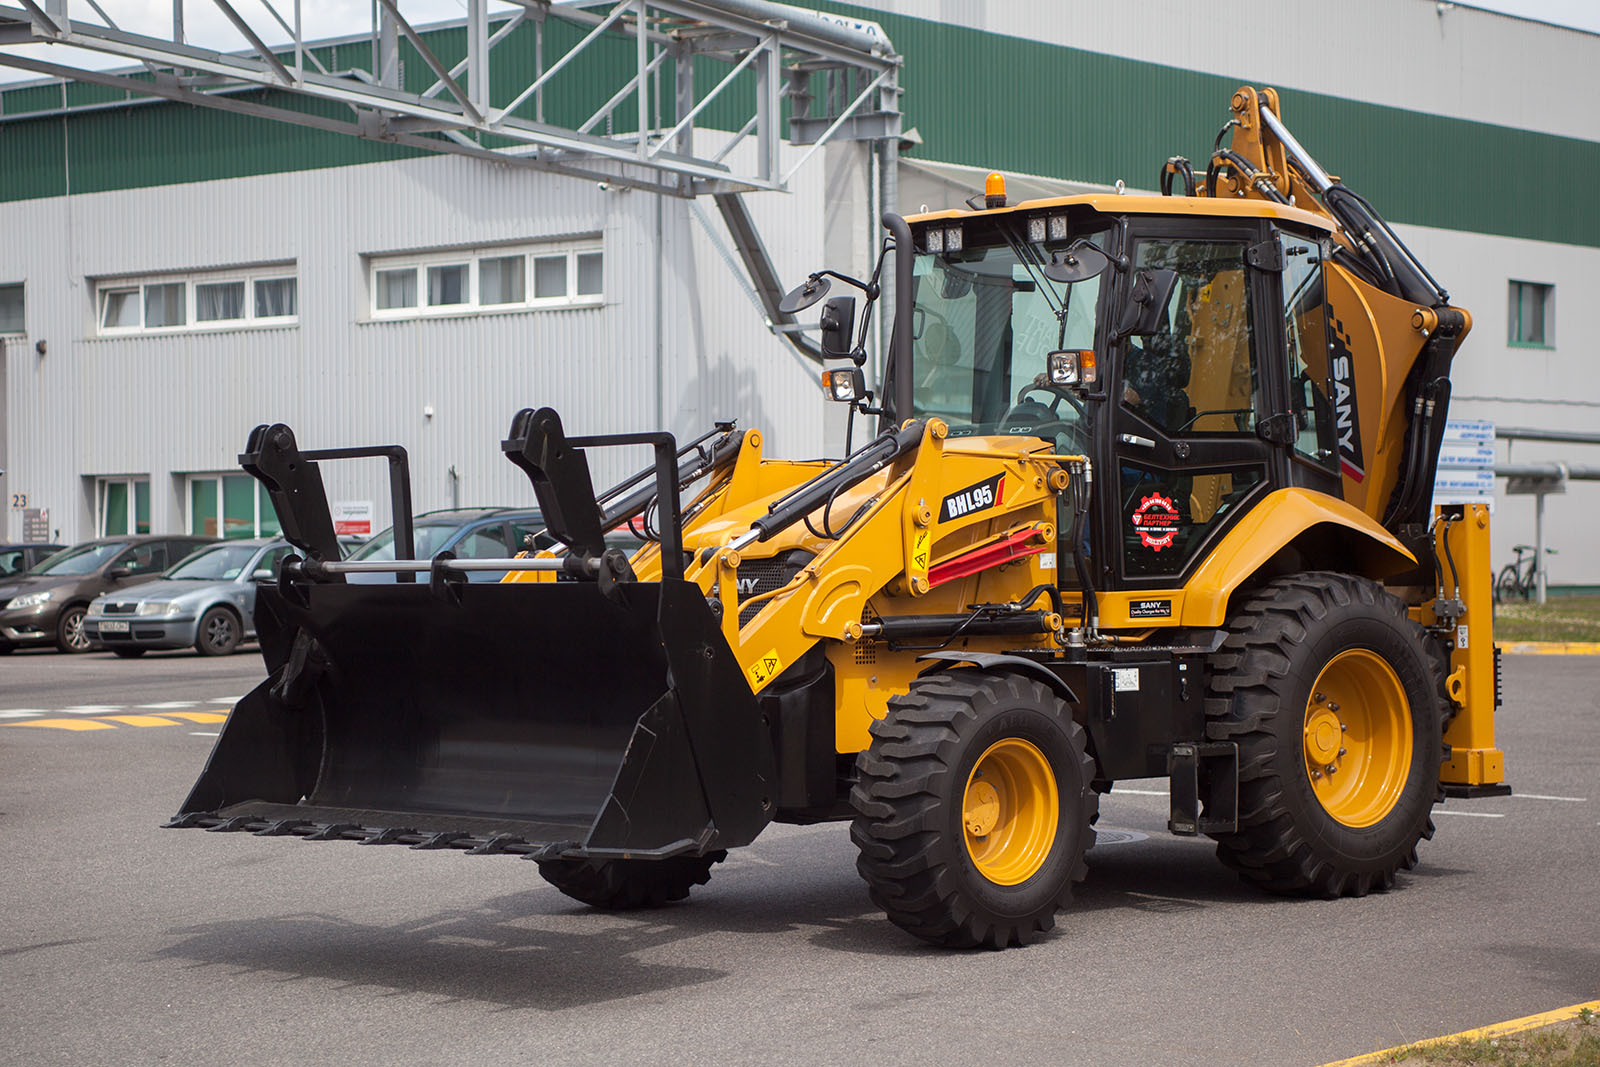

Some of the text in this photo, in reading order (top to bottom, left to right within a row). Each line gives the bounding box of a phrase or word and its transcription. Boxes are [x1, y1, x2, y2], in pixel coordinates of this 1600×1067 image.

[1333, 356, 1354, 453] SANY
[13, 494, 27, 507] 23
[946, 484, 993, 519] BHL95
